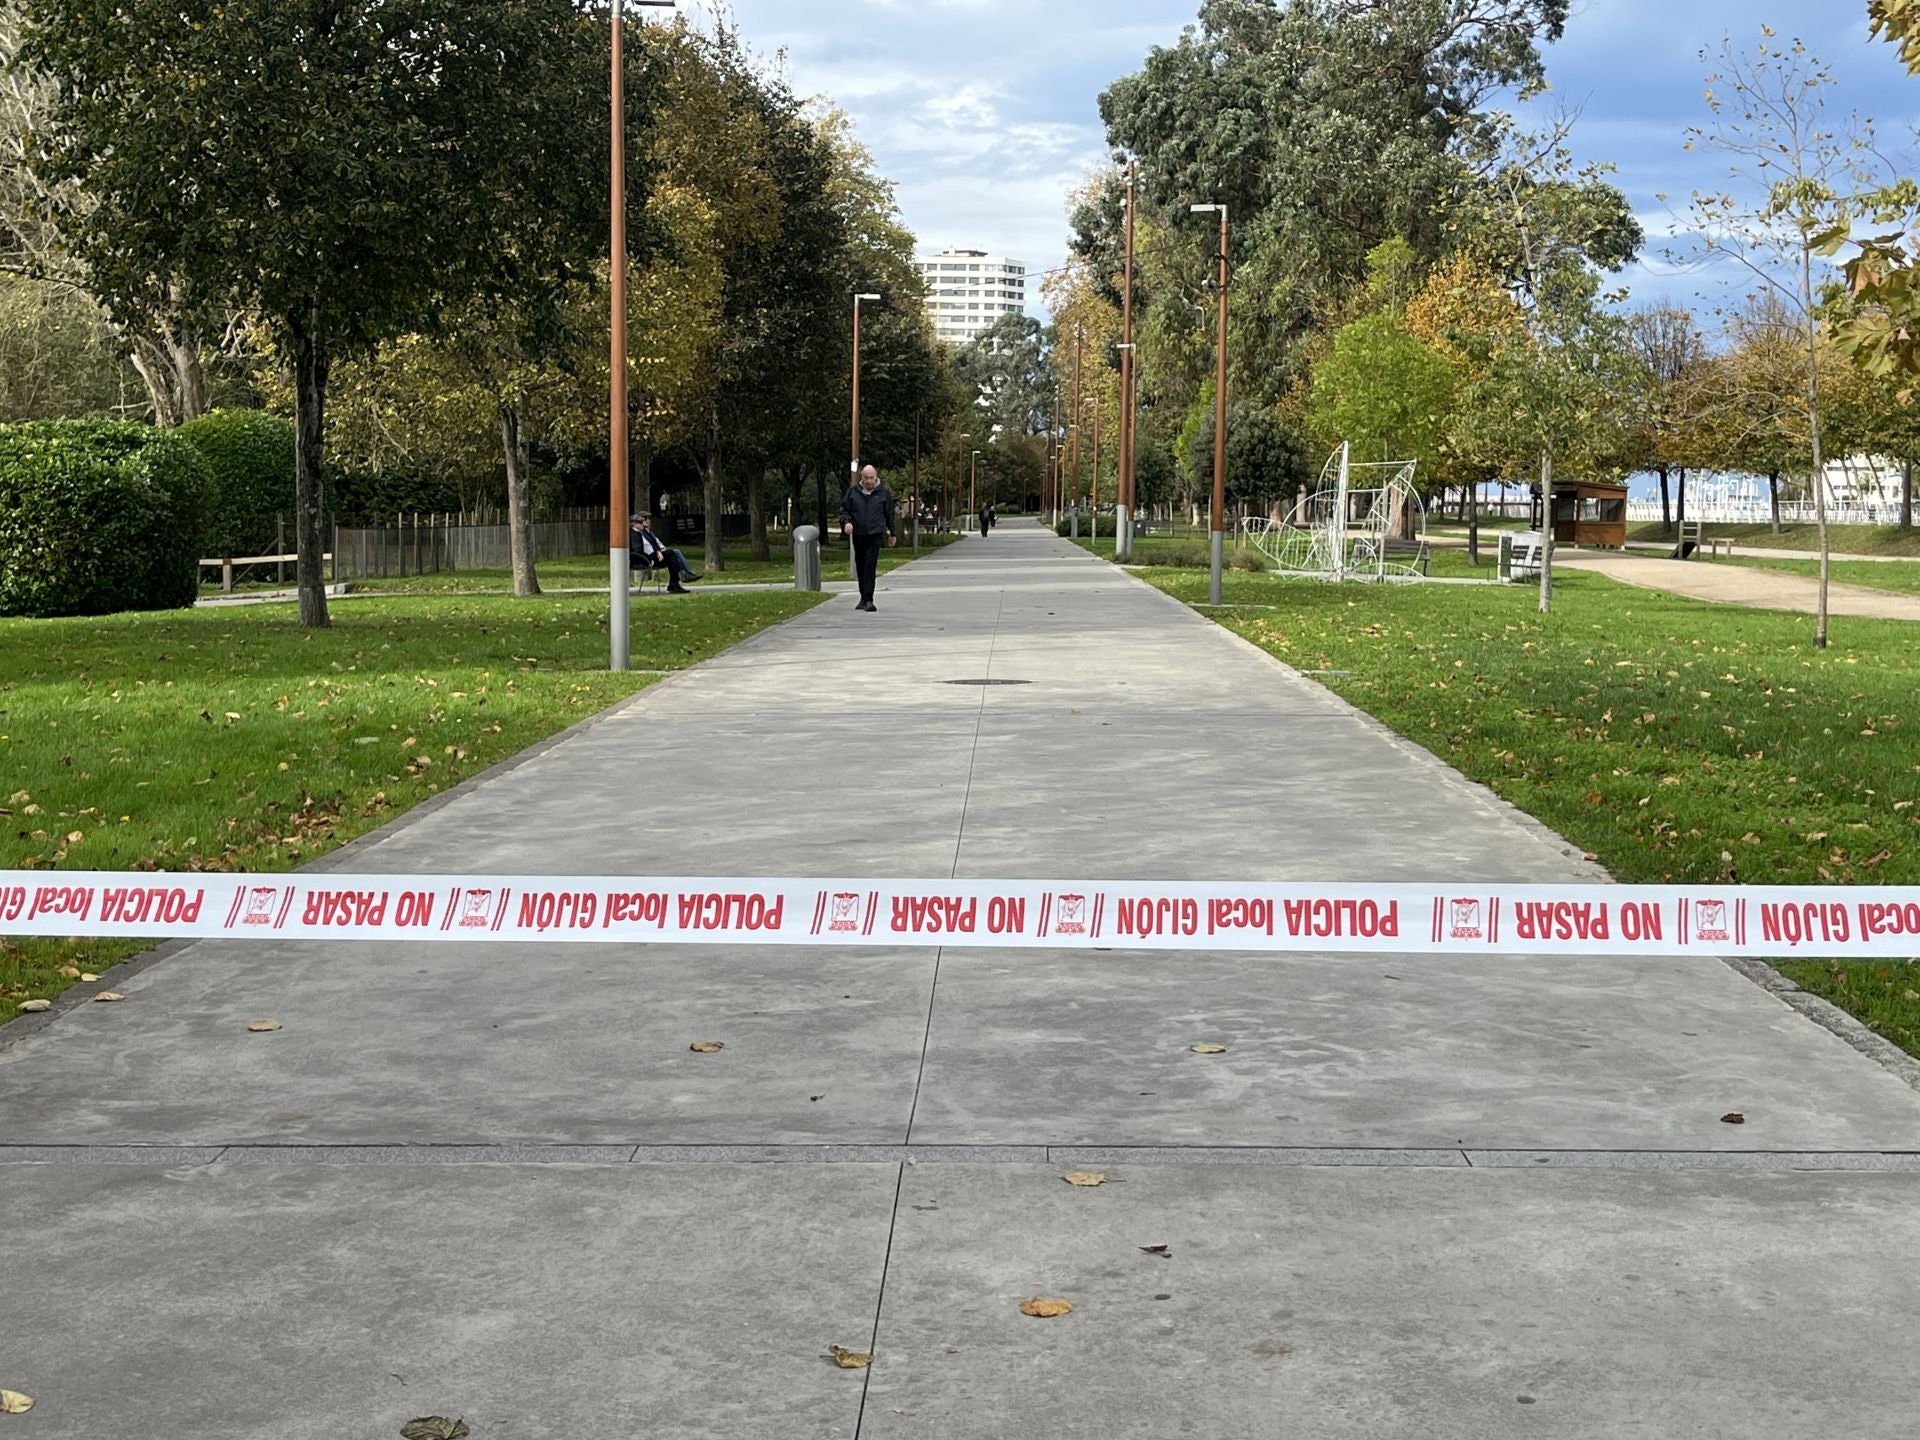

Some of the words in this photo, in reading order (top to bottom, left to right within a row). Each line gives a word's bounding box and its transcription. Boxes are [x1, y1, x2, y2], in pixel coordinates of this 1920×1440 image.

[27, 887, 94, 921] local
[99, 887, 204, 923] POLICIA
[301, 890, 388, 926] PASAR
[394, 890, 434, 927] NO
[518, 891, 597, 931] GIJÓN
[602, 892, 668, 928] local
[677, 893, 783, 930] POLICIA
[890, 896, 977, 932] PASAR
[986, 896, 1025, 933] NO
[1117, 898, 1198, 937] GIJÓN
[1207, 898, 1273, 935] local
[1283, 899, 1398, 937] POLICIA
[1515, 902, 1609, 940] PASAR
[1620, 902, 1662, 940] NO
[1858, 903, 1920, 940] ocal
[1761, 903, 1850, 945] GIJÓN
